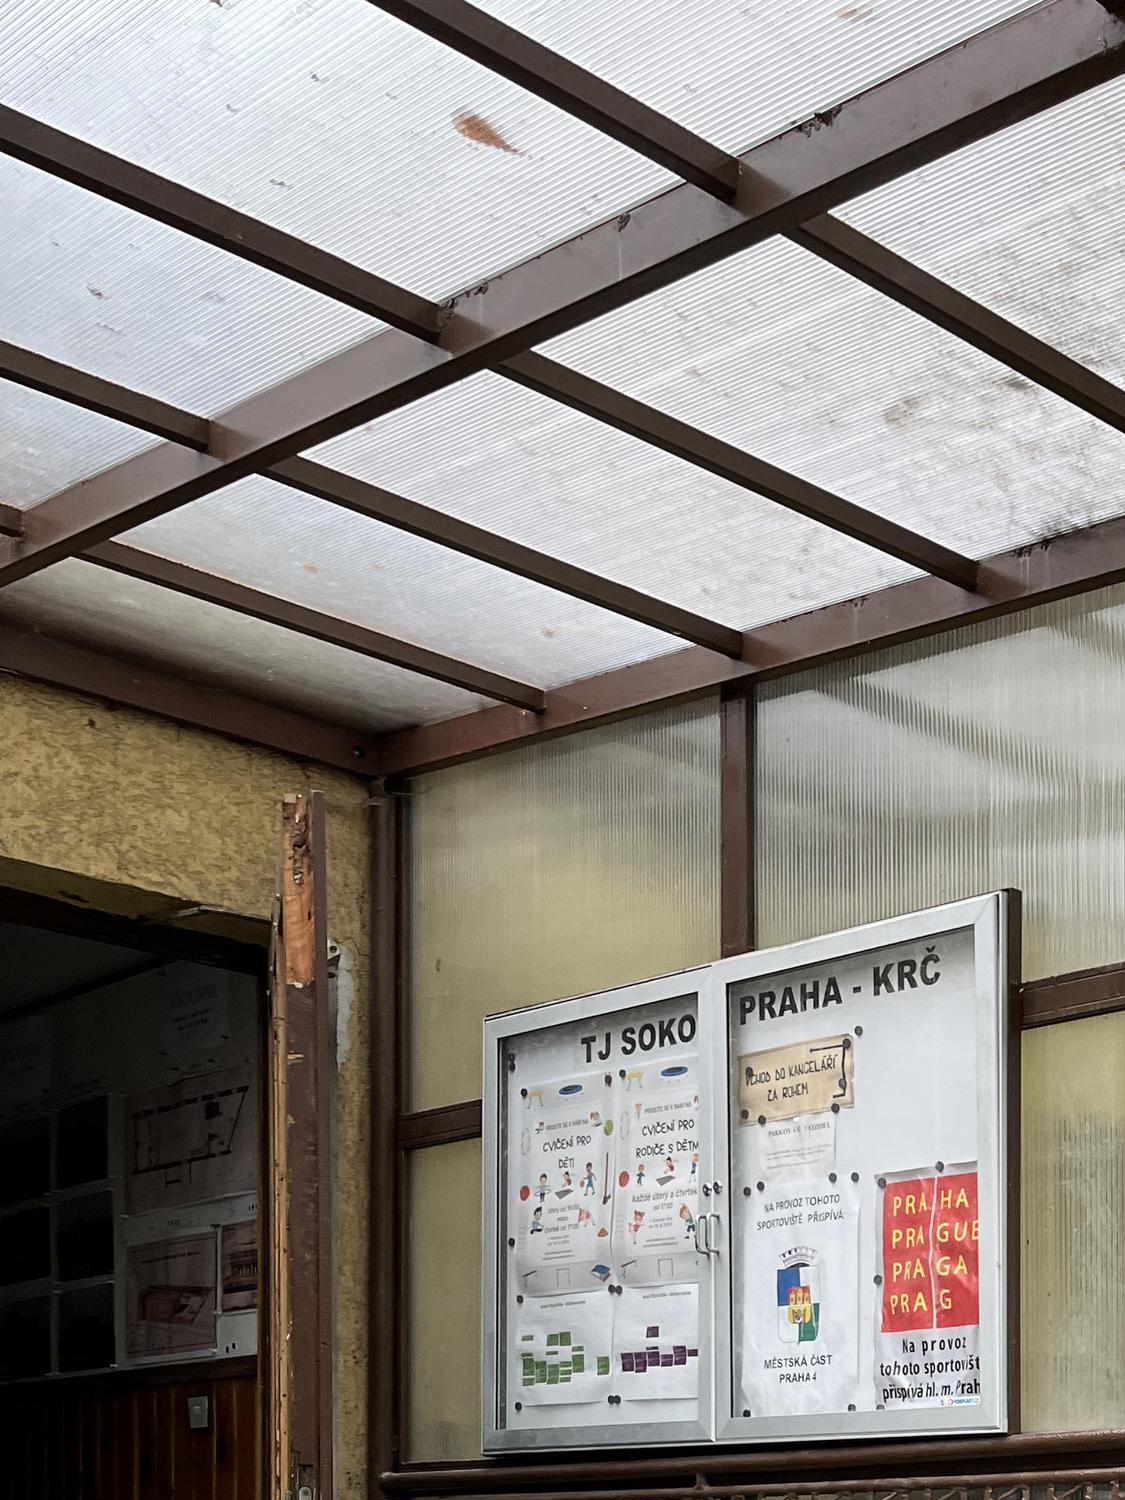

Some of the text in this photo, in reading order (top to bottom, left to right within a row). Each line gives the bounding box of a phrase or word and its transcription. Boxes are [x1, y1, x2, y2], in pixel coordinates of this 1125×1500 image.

[581, 946, 941, 1063] TJ SOKO PRAHA - KRČ
[775, 1067, 786, 1081] DO
[767, 1083, 809, 1102] ZA ROHEM
[642, 1119, 695, 1137] CVIČENÍ PRO
[543, 1135, 592, 1153] CVIČENÍ PRO
[636, 1140, 699, 1158] RODIČE S DĚTM
[558, 1157, 574, 1169] DĚTI
[764, 1194, 840, 1213] NA PROVOZ TOHOTO
[757, 1213, 803, 1230] SPORTOVIŠTĚ
[902, 1337, 966, 1356] Na provoz
[880, 1354, 980, 1378] tohoto sportovišt
[780, 1372, 817, 1384] PRAHA 4
[882, 1378, 980, 1403] přispívá hl. m. Prah
